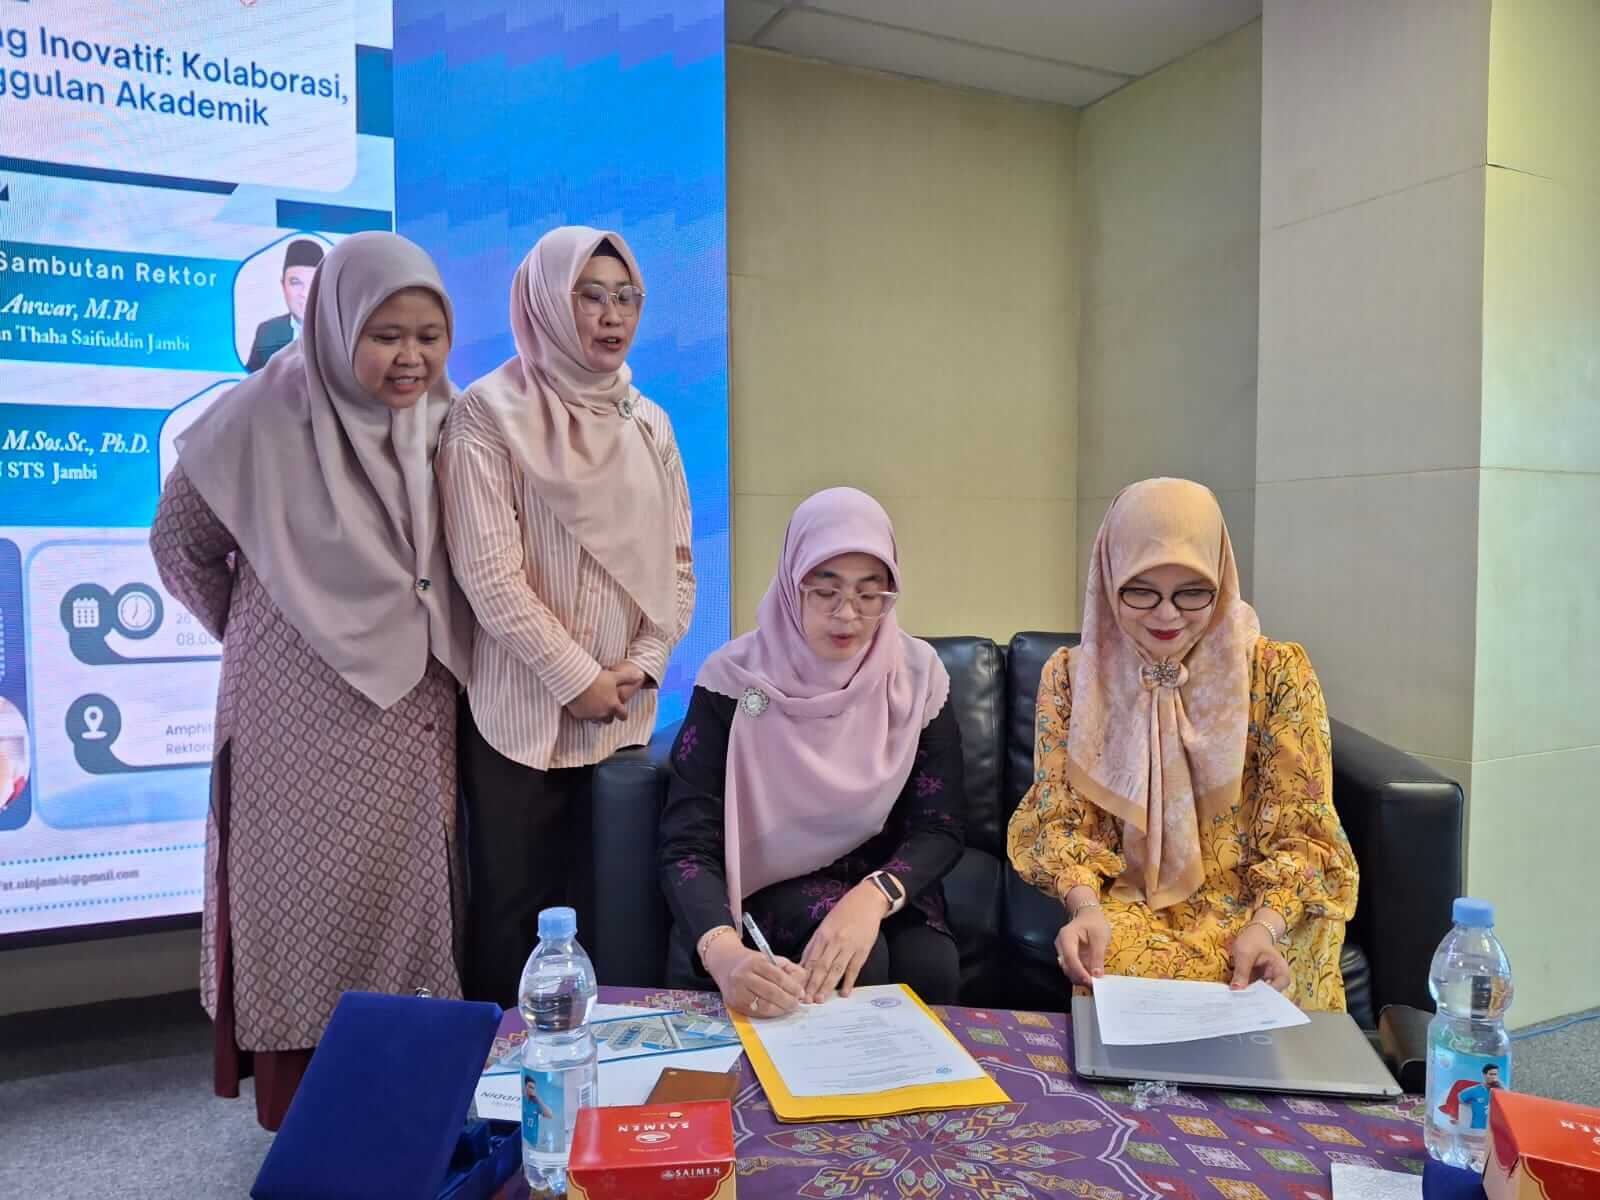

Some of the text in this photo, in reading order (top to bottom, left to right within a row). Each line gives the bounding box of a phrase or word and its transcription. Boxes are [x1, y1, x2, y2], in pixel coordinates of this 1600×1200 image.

[0, 26, 348, 104] g Inovatif: Kolaborasi,
[116, 81, 269, 126] Akademik
[136, 263, 217, 287] Rektor
[0, 293, 139, 321] Anwar, M.Pd
[0, 325, 190, 353] n Thaha Saifuddin Jambi
[100, 432, 150, 454] Ph.D.
[7, 461, 45, 479] STS
[52, 462, 97, 484] Jambi
[618, 1122, 689, 1132] SAIMEN
[675, 1167, 720, 1177] SAIMEN
